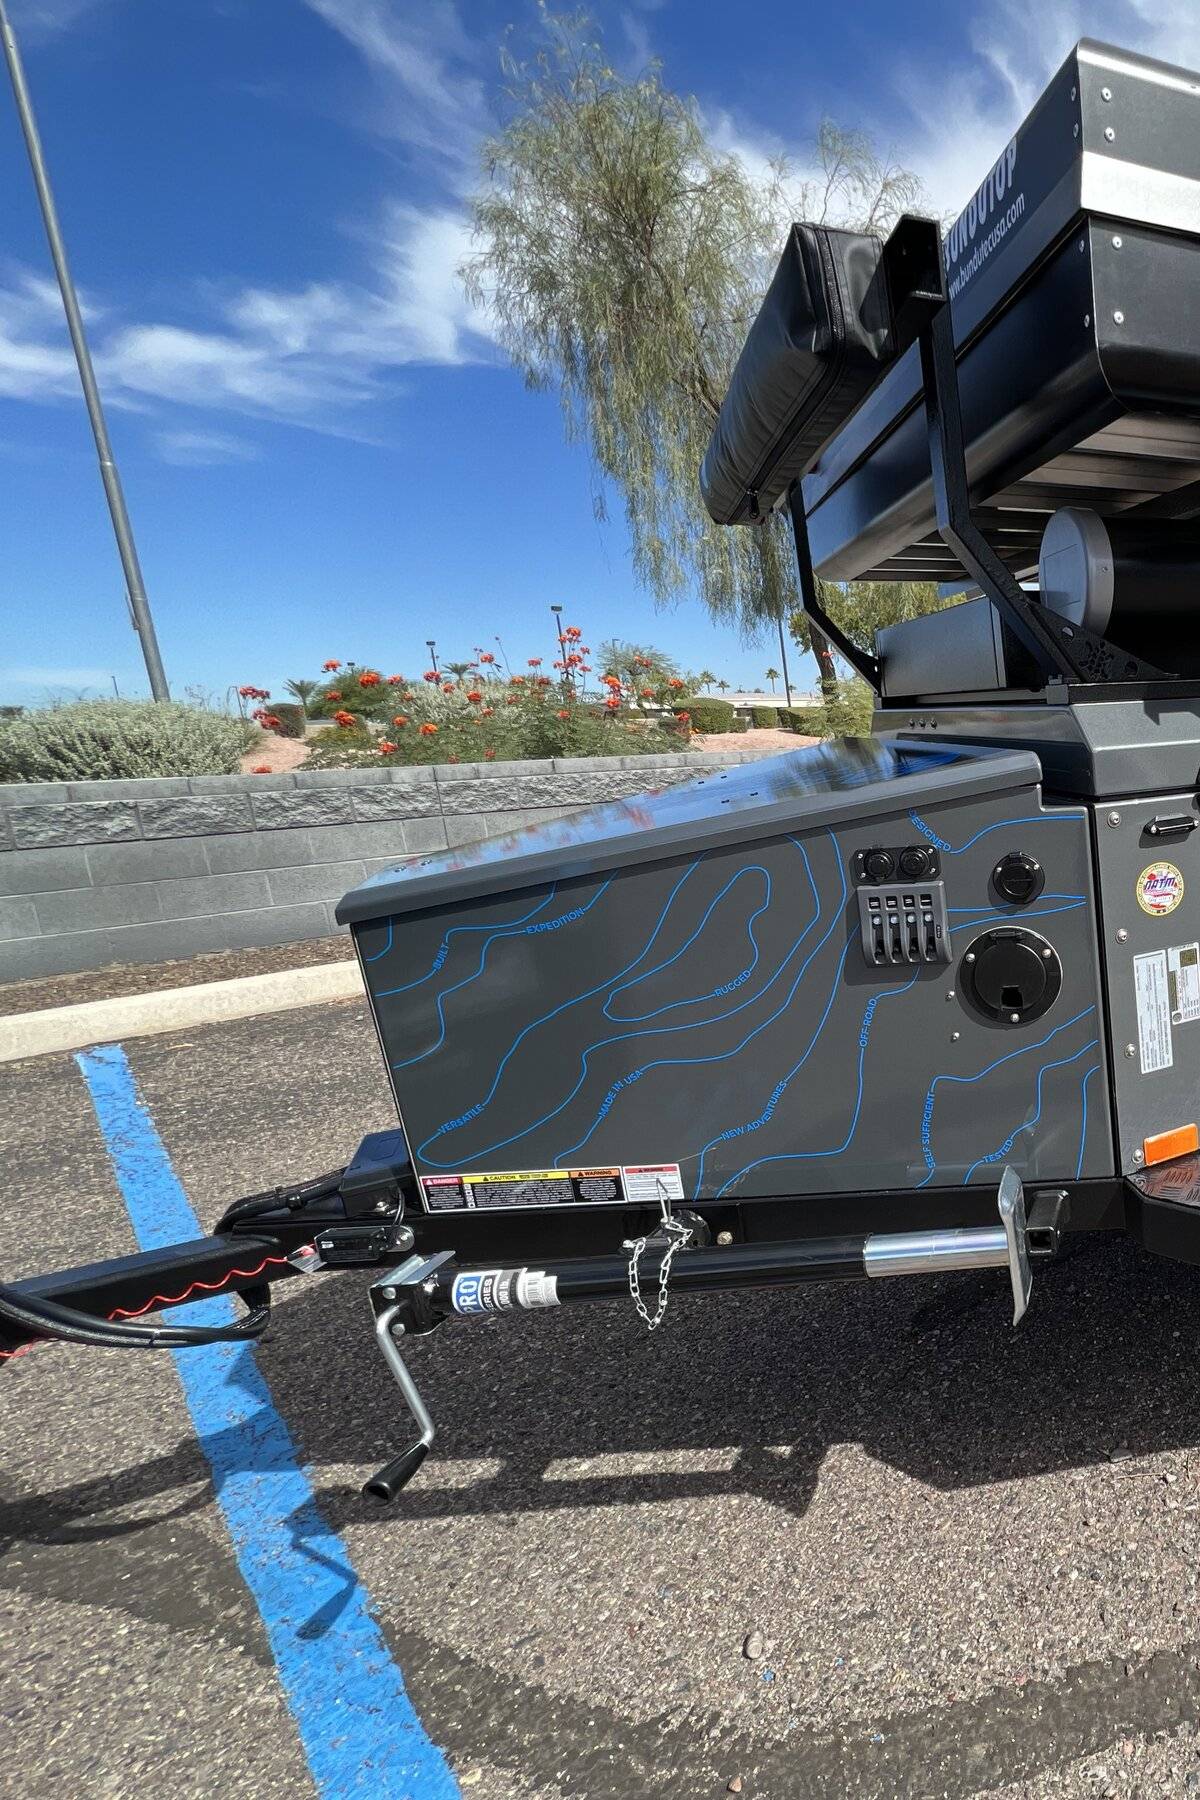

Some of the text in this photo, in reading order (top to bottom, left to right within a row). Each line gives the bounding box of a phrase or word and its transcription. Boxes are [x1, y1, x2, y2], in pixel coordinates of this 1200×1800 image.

[949, 193, 1025, 301] ww.bundutecusa.com
[909, 808, 951, 851] DESIGNED
[527, 907, 585, 934] EXPEDITION
[432, 942, 449, 970] BUILT
[715, 970, 751, 996] RUGGED
[599, 1070, 643, 1118] MADE IN USA
[438, 1103, 485, 1134] VERSATILE
[721, 1080, 787, 1140] NEW ADVENTURES
[983, 1139, 1013, 1162] TESTED
